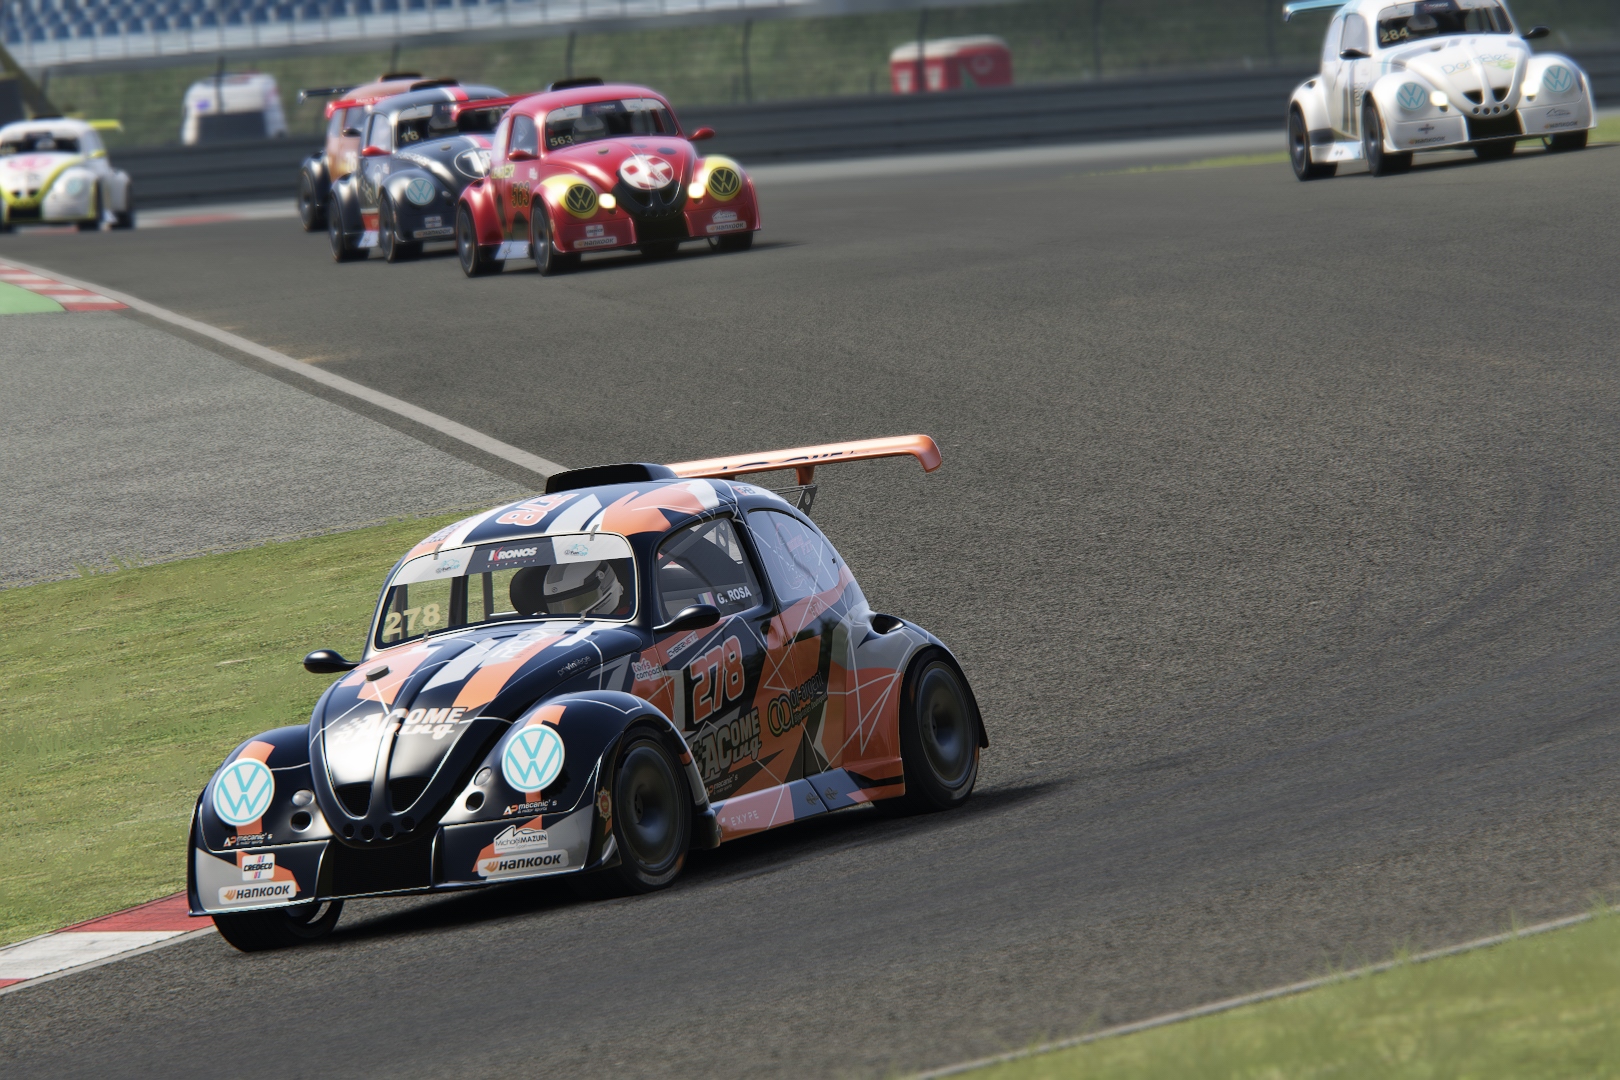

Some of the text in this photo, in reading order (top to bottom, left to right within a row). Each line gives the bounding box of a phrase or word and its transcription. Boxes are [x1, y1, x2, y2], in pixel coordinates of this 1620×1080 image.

[1381, 26, 1409, 42] 284
[400, 130, 419, 142] 18
[550, 134, 573, 147] 563
[511, 181, 531, 208] 563
[488, 546, 538, 562] KRONOS
[716, 585, 752, 605] G. ROSA
[384, 603, 441, 636] 278
[690, 634, 745, 725] 278
